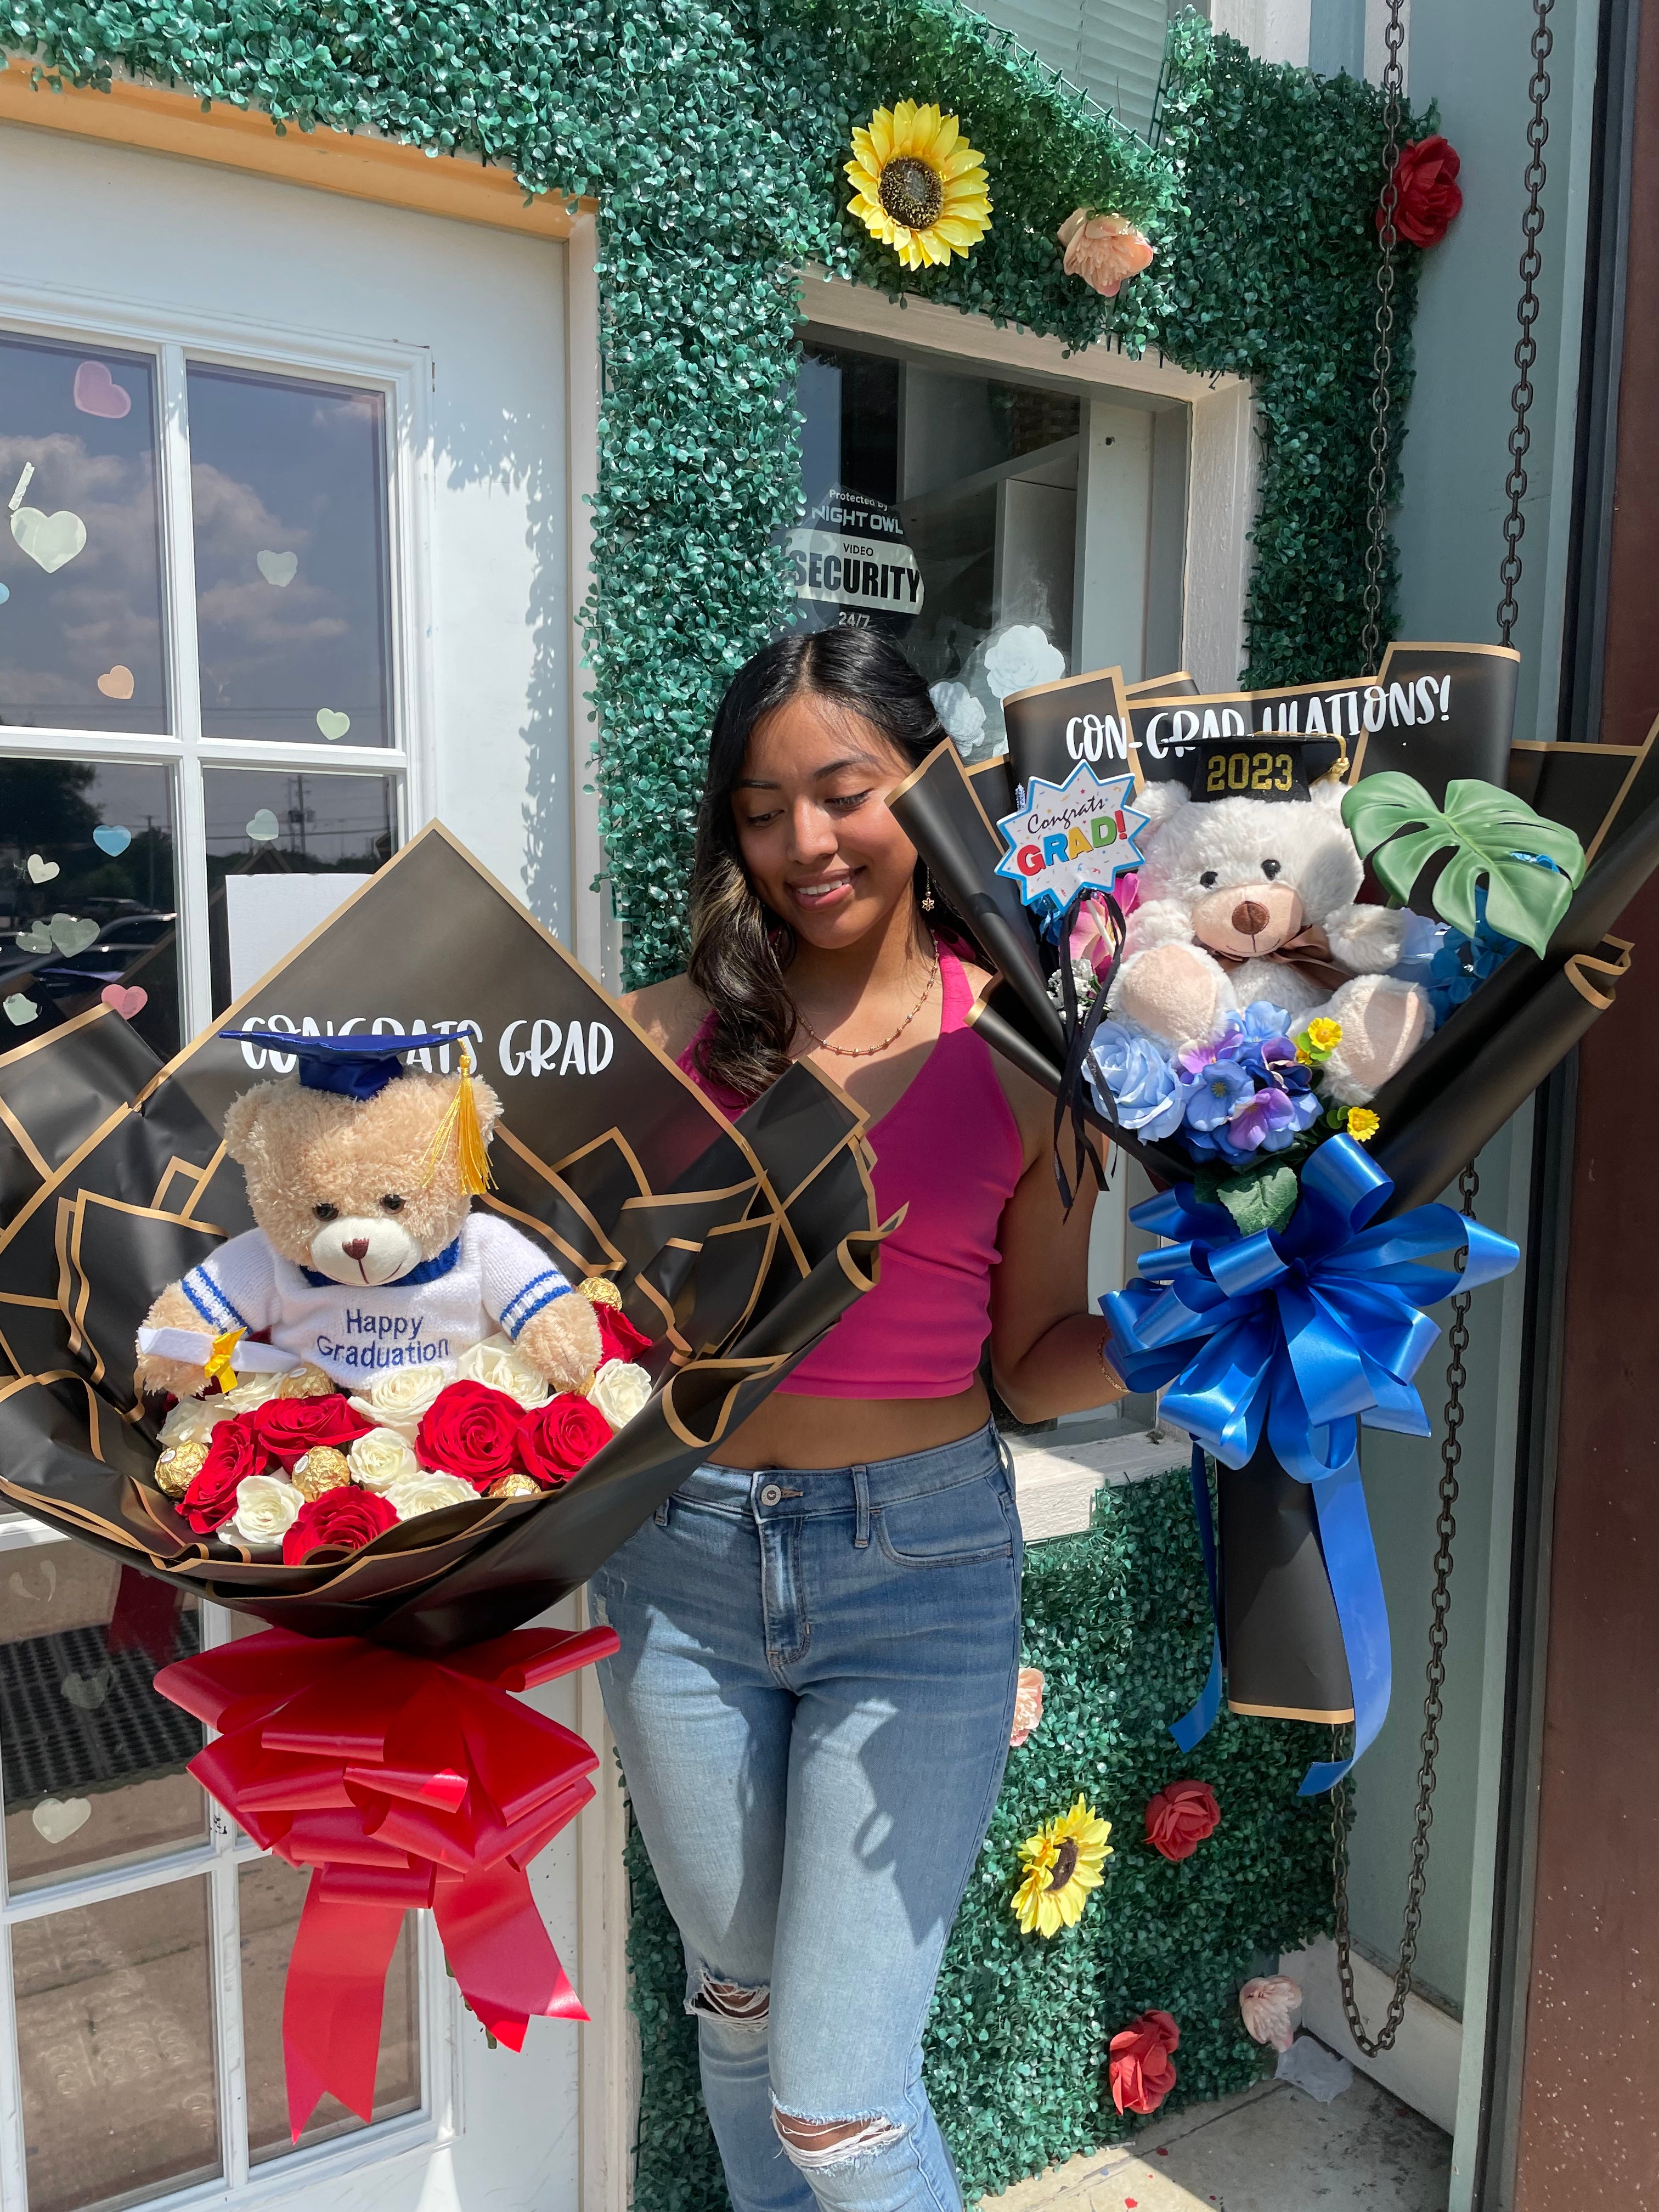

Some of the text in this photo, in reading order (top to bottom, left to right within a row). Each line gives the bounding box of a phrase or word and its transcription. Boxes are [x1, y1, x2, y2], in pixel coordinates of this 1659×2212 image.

[829, 489, 875, 506] Protected
[811, 505, 904, 535] NIGHT OWL
[843, 543, 874, 557] VIDEO
[788, 550, 920, 603] SECURITY
[838, 611, 870, 628] 24/7
[1207, 752, 1293, 792] 2023
[1028, 795, 1105, 834] Congrats
[1017, 810, 1127, 876] GRAD!
[499, 1020, 614, 1077] GRAD
[346, 1309, 424, 1340] Happy
[317, 1335, 449, 1368] Graduation
